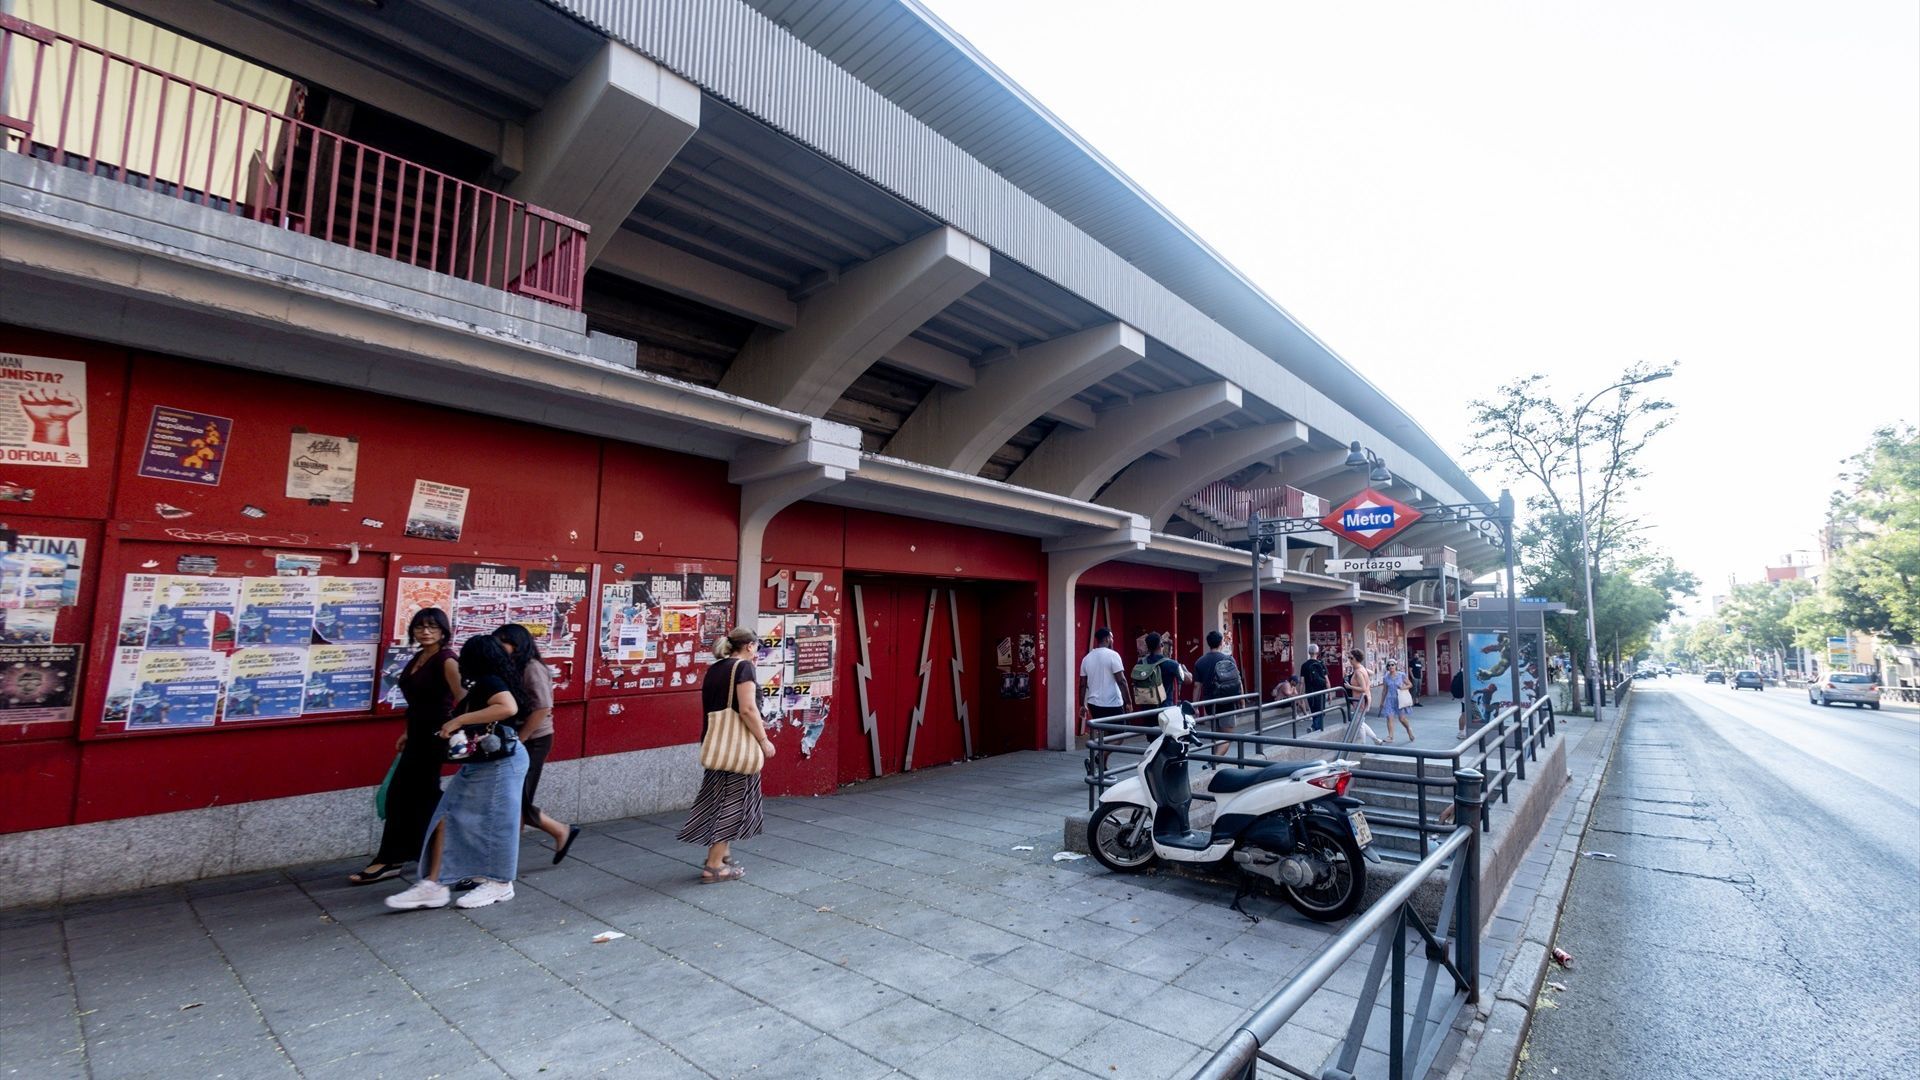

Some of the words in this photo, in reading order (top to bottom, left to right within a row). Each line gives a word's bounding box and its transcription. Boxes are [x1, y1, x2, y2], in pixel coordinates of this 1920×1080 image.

[8, 450, 62, 462] OFICIAL
[1346, 512, 1391, 527] Metro
[1344, 560, 1402, 570] Portazgo
[475, 573, 516, 587] GUERRA
[549, 579, 587, 592] GUERRA
[652, 580, 681, 592] GUERRA
[703, 580, 731, 592] GUERRA
[768, 570, 823, 608] 17
[762, 687, 780, 697] az
[783, 685, 811, 698] paz
